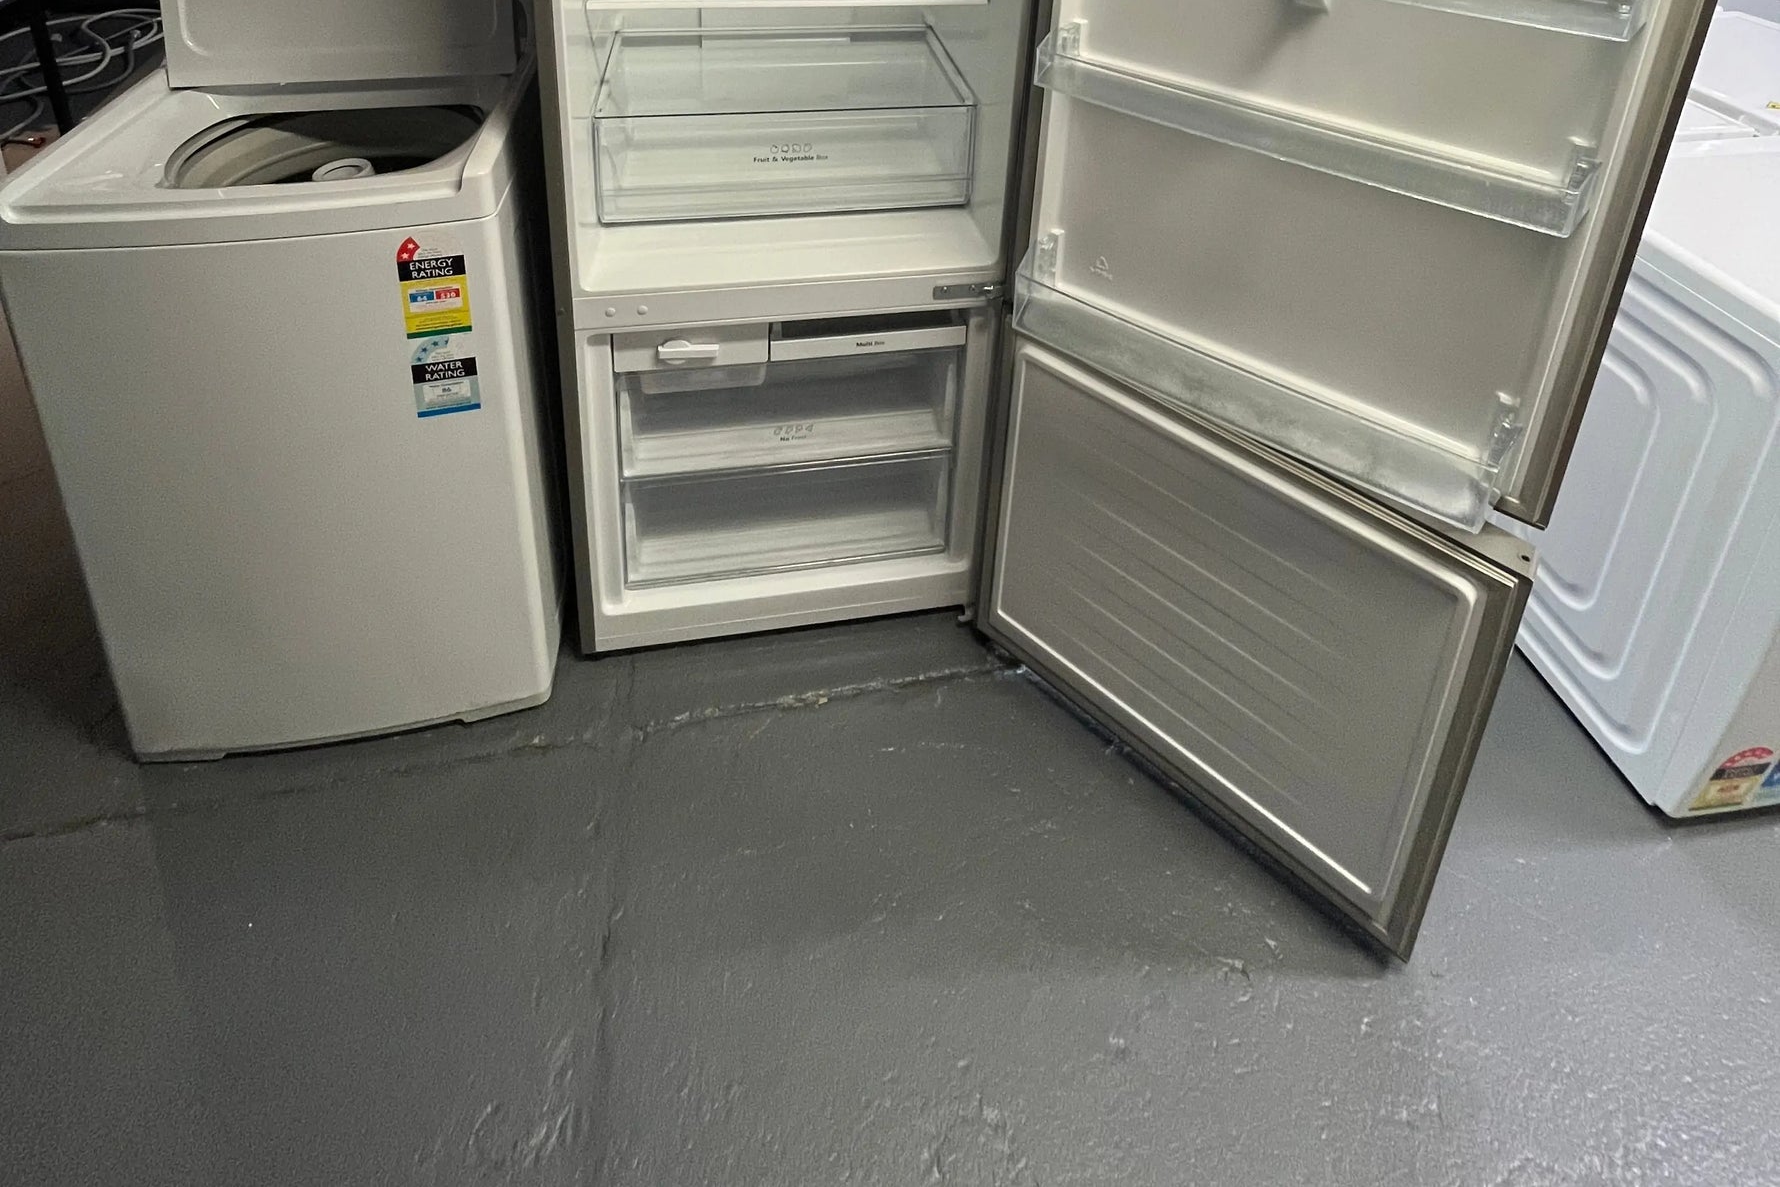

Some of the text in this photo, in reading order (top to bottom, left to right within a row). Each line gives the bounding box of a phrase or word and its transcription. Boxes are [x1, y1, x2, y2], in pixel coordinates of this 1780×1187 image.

[781, 155, 814, 163] Vegetable
[409, 258, 453, 271] ENERGY
[411, 267, 453, 279] RATING
[425, 361, 463, 372] WATER
[425, 369, 465, 381] RATING
